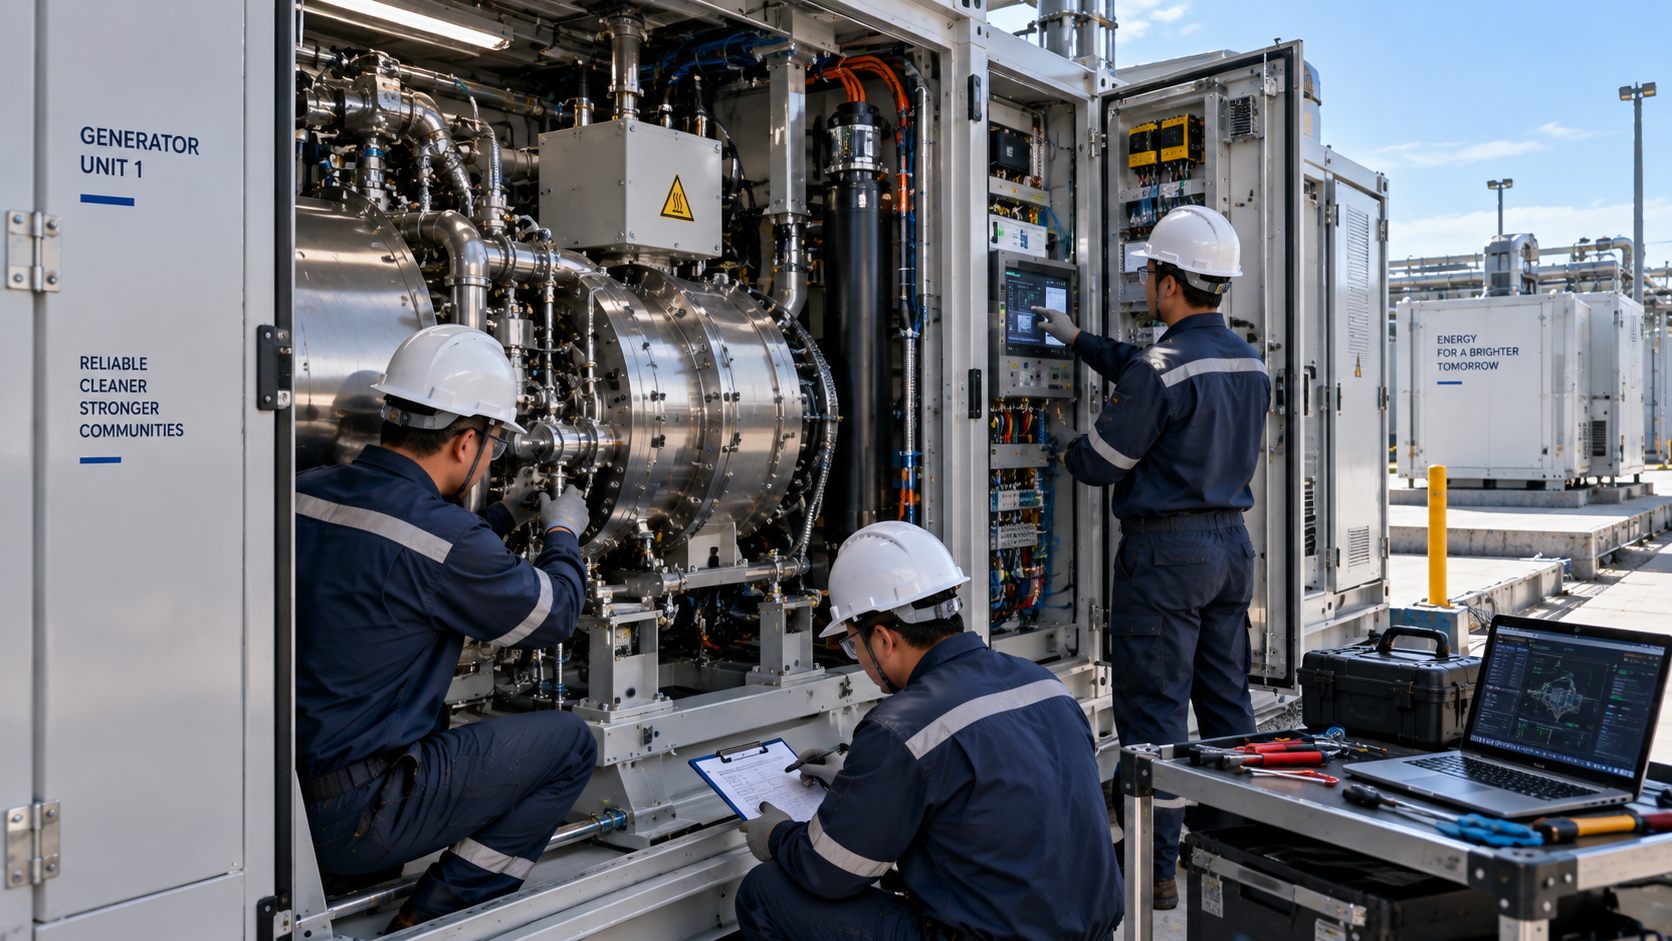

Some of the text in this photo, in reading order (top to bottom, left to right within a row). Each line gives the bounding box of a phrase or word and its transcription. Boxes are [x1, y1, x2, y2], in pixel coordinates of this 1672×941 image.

[80, 126, 200, 155] GENERATOR
[80, 155, 142, 178] UNIT 1
[1437, 334, 1477, 344] ENERGY
[1437, 347, 1519, 357] FOR A BRIGHTER
[80, 356, 147, 371] RELIABLE
[1437, 361, 1499, 371] TOMORROW
[80, 378, 147, 394] CLEANER
[80, 401, 159, 416] STRONGER
[80, 423, 184, 438] COMMUNITIES
